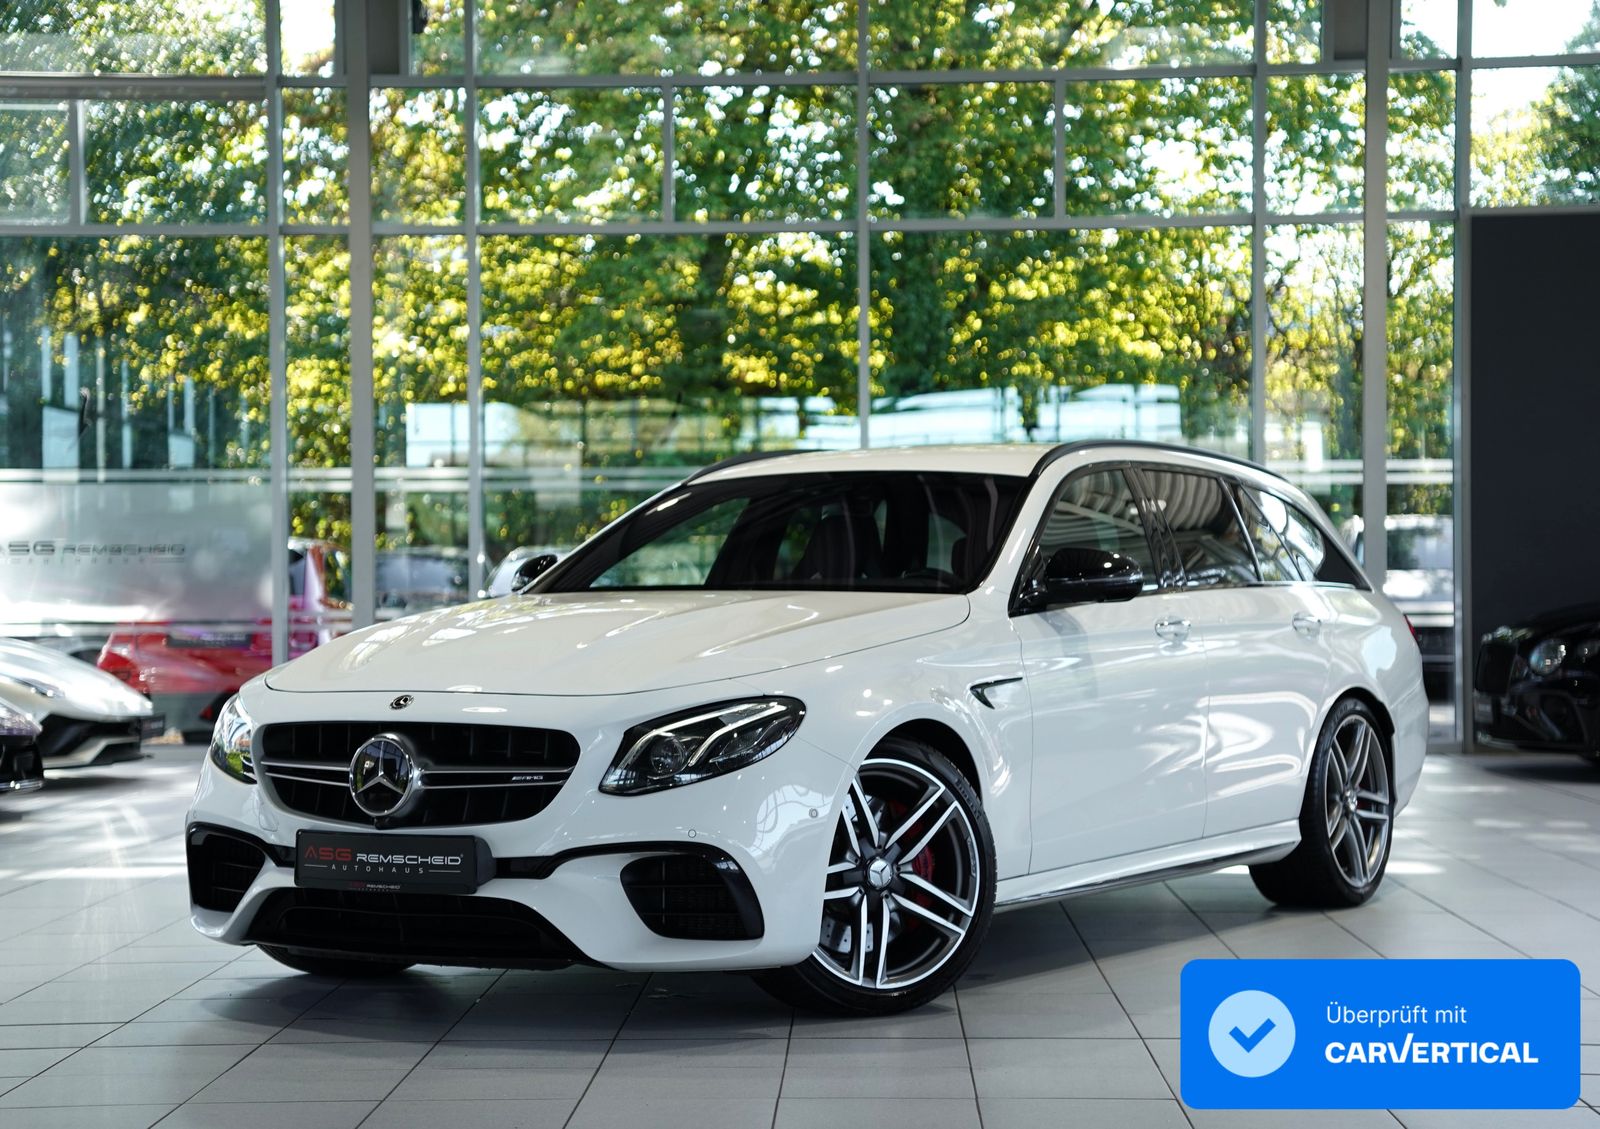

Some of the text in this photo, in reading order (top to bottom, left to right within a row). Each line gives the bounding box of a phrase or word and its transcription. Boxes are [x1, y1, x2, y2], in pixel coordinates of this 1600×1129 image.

[304, 845, 462, 865] ASG REMSCHEID
[331, 864, 424, 874] AUTOHAUS
